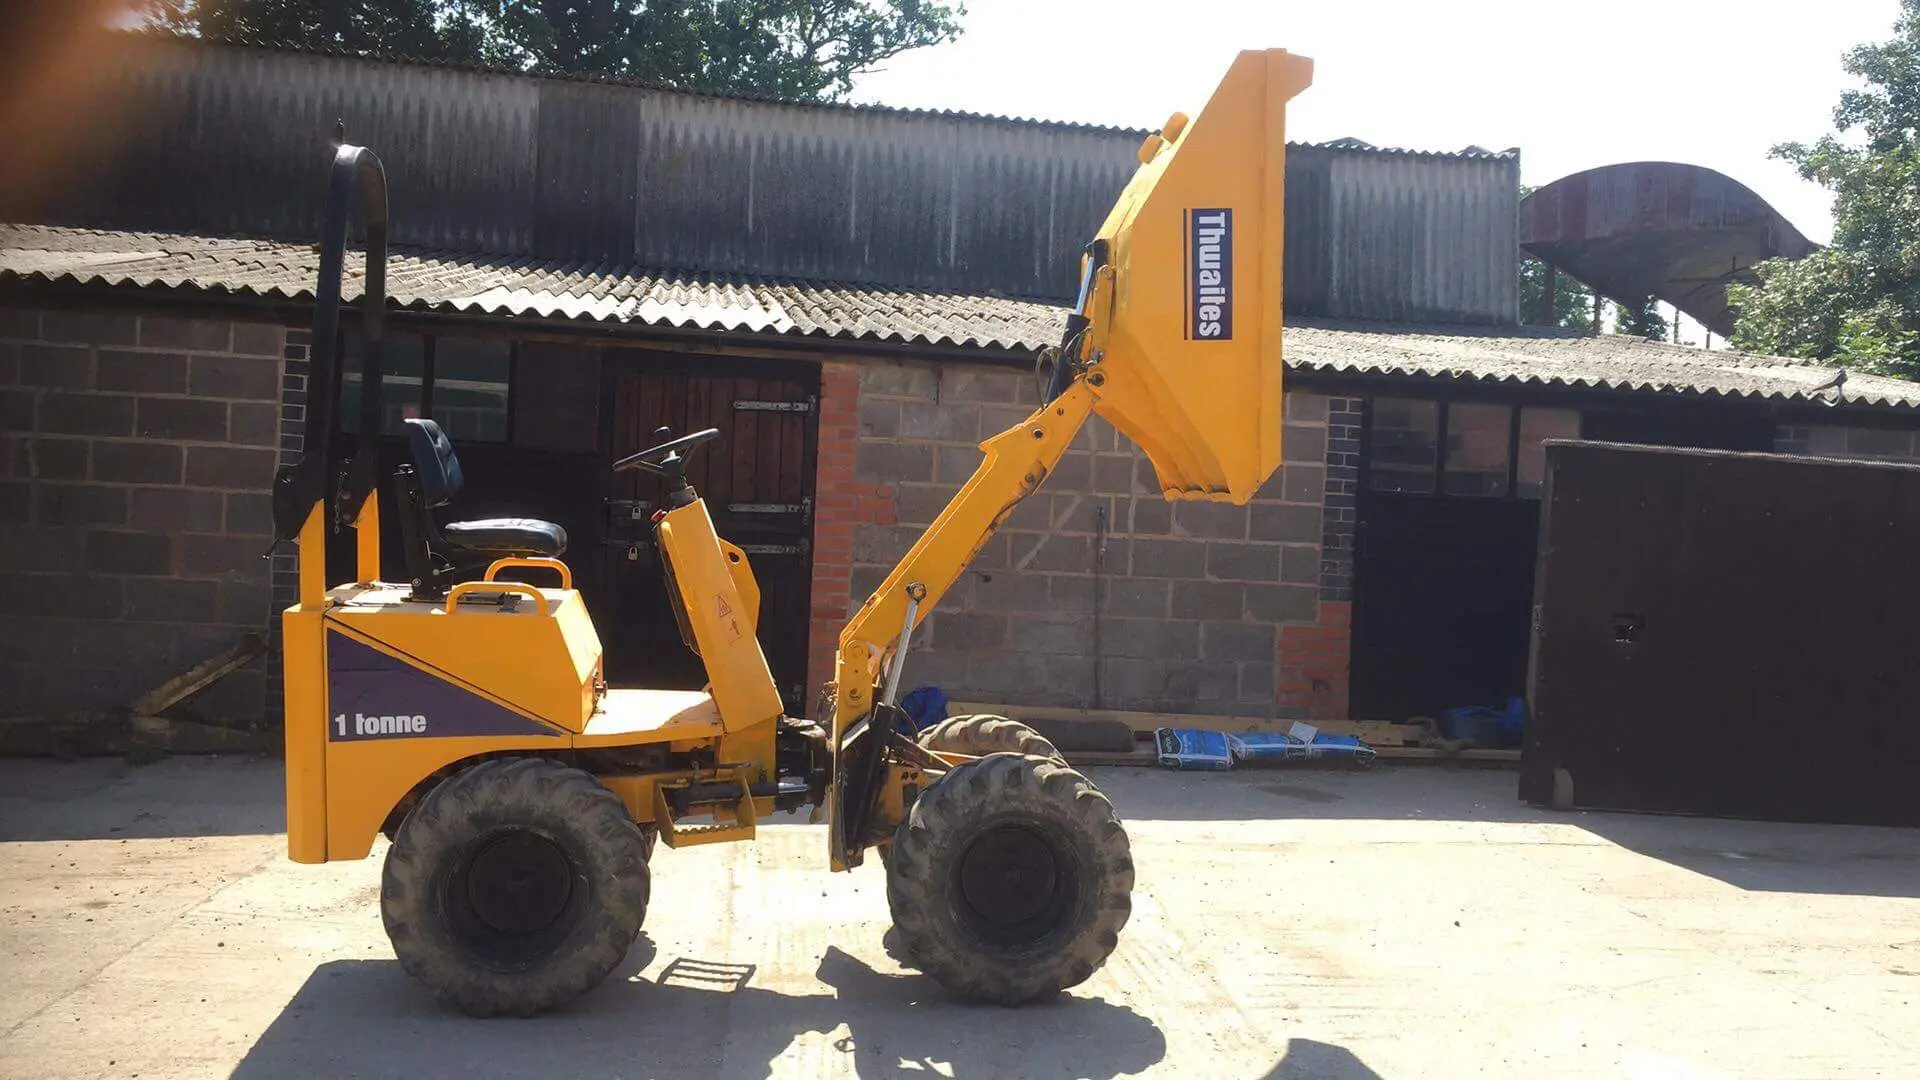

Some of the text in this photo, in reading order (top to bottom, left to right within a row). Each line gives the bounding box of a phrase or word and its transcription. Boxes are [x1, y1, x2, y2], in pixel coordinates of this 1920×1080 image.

[1199, 212, 1225, 336] Thwaites
[335, 713, 427, 736] 1 tonne
